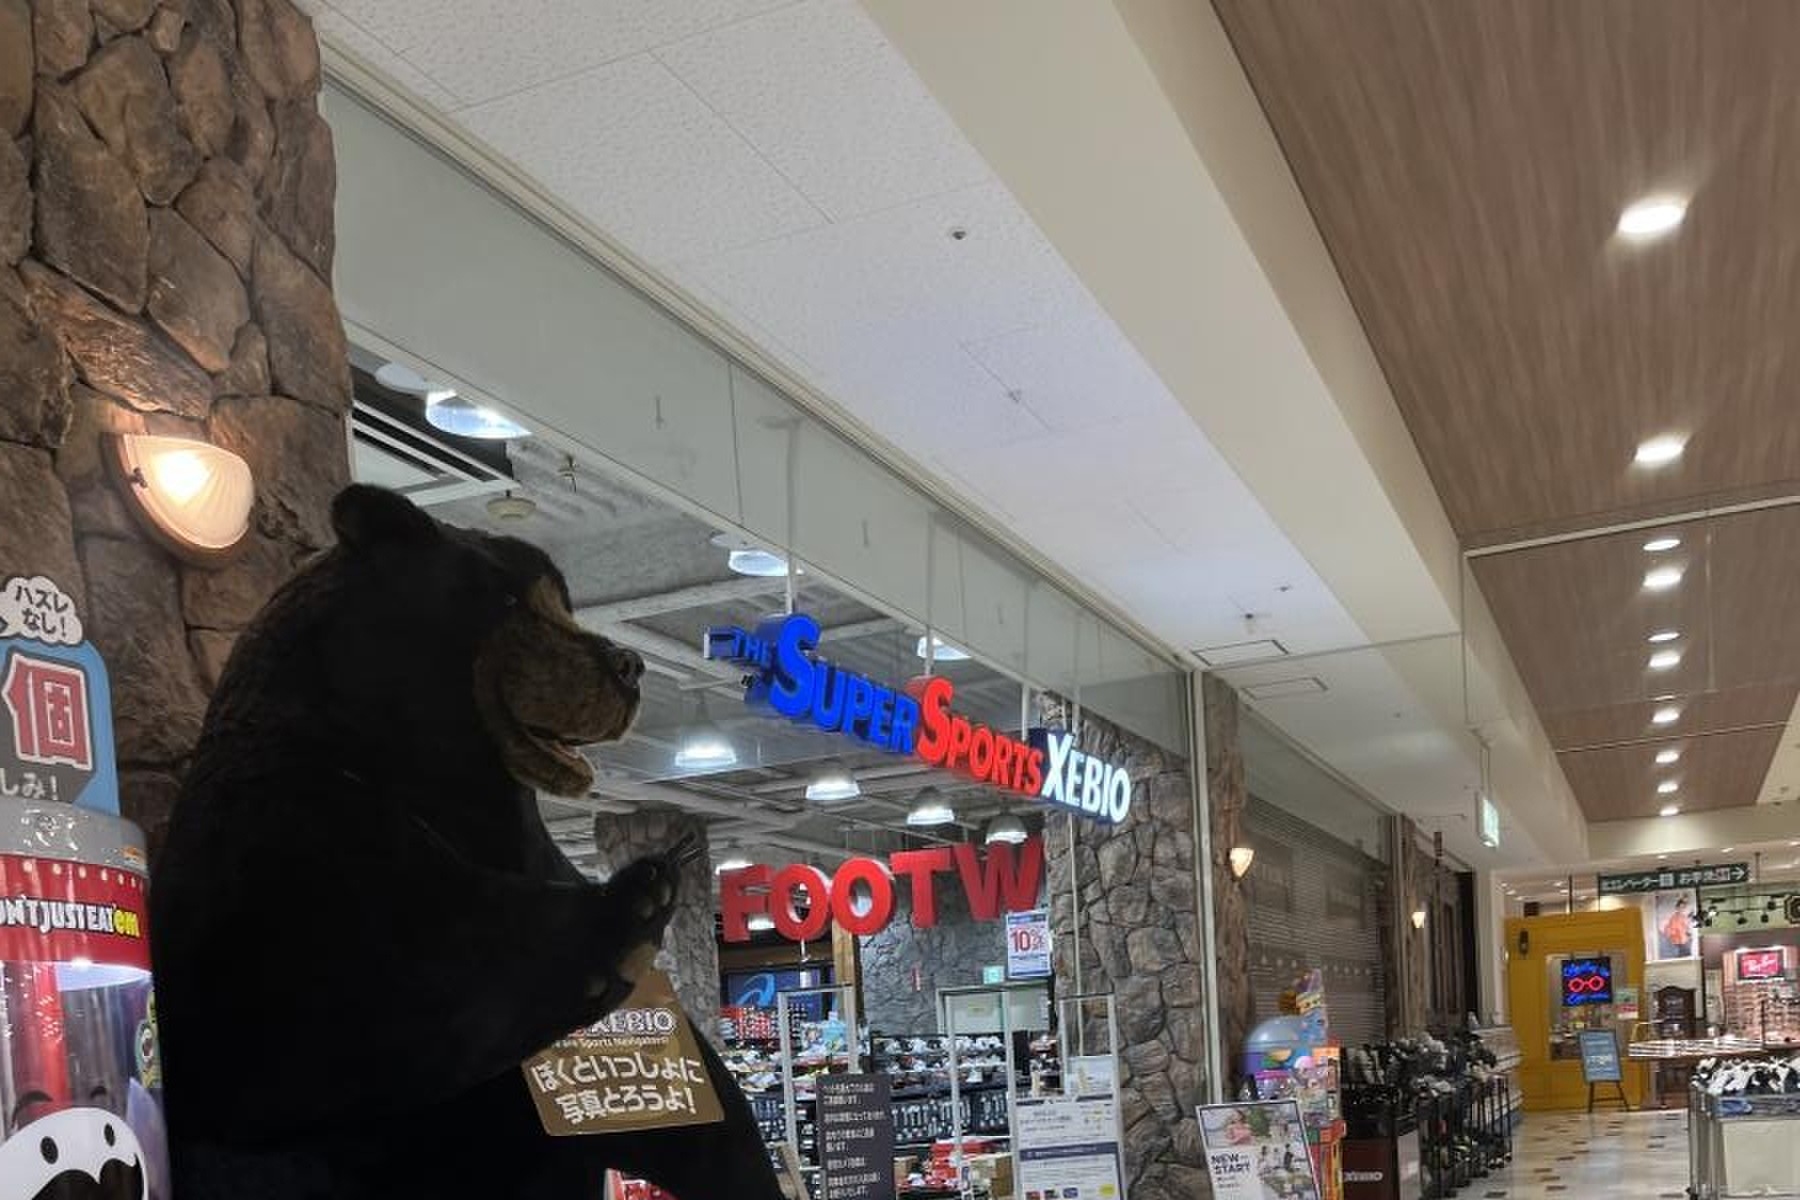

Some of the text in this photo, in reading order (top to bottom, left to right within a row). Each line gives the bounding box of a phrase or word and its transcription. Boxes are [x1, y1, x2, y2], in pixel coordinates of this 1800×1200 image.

[770, 613, 919, 756] SUPER
[917, 676, 1044, 797] SPORTS
[1040, 731, 1132, 824] XEBIO
[39, 899, 86, 934] JUST
[85, 903, 115, 933] EAT
[530, 1050, 705, 1093] ぼくといっしょに
